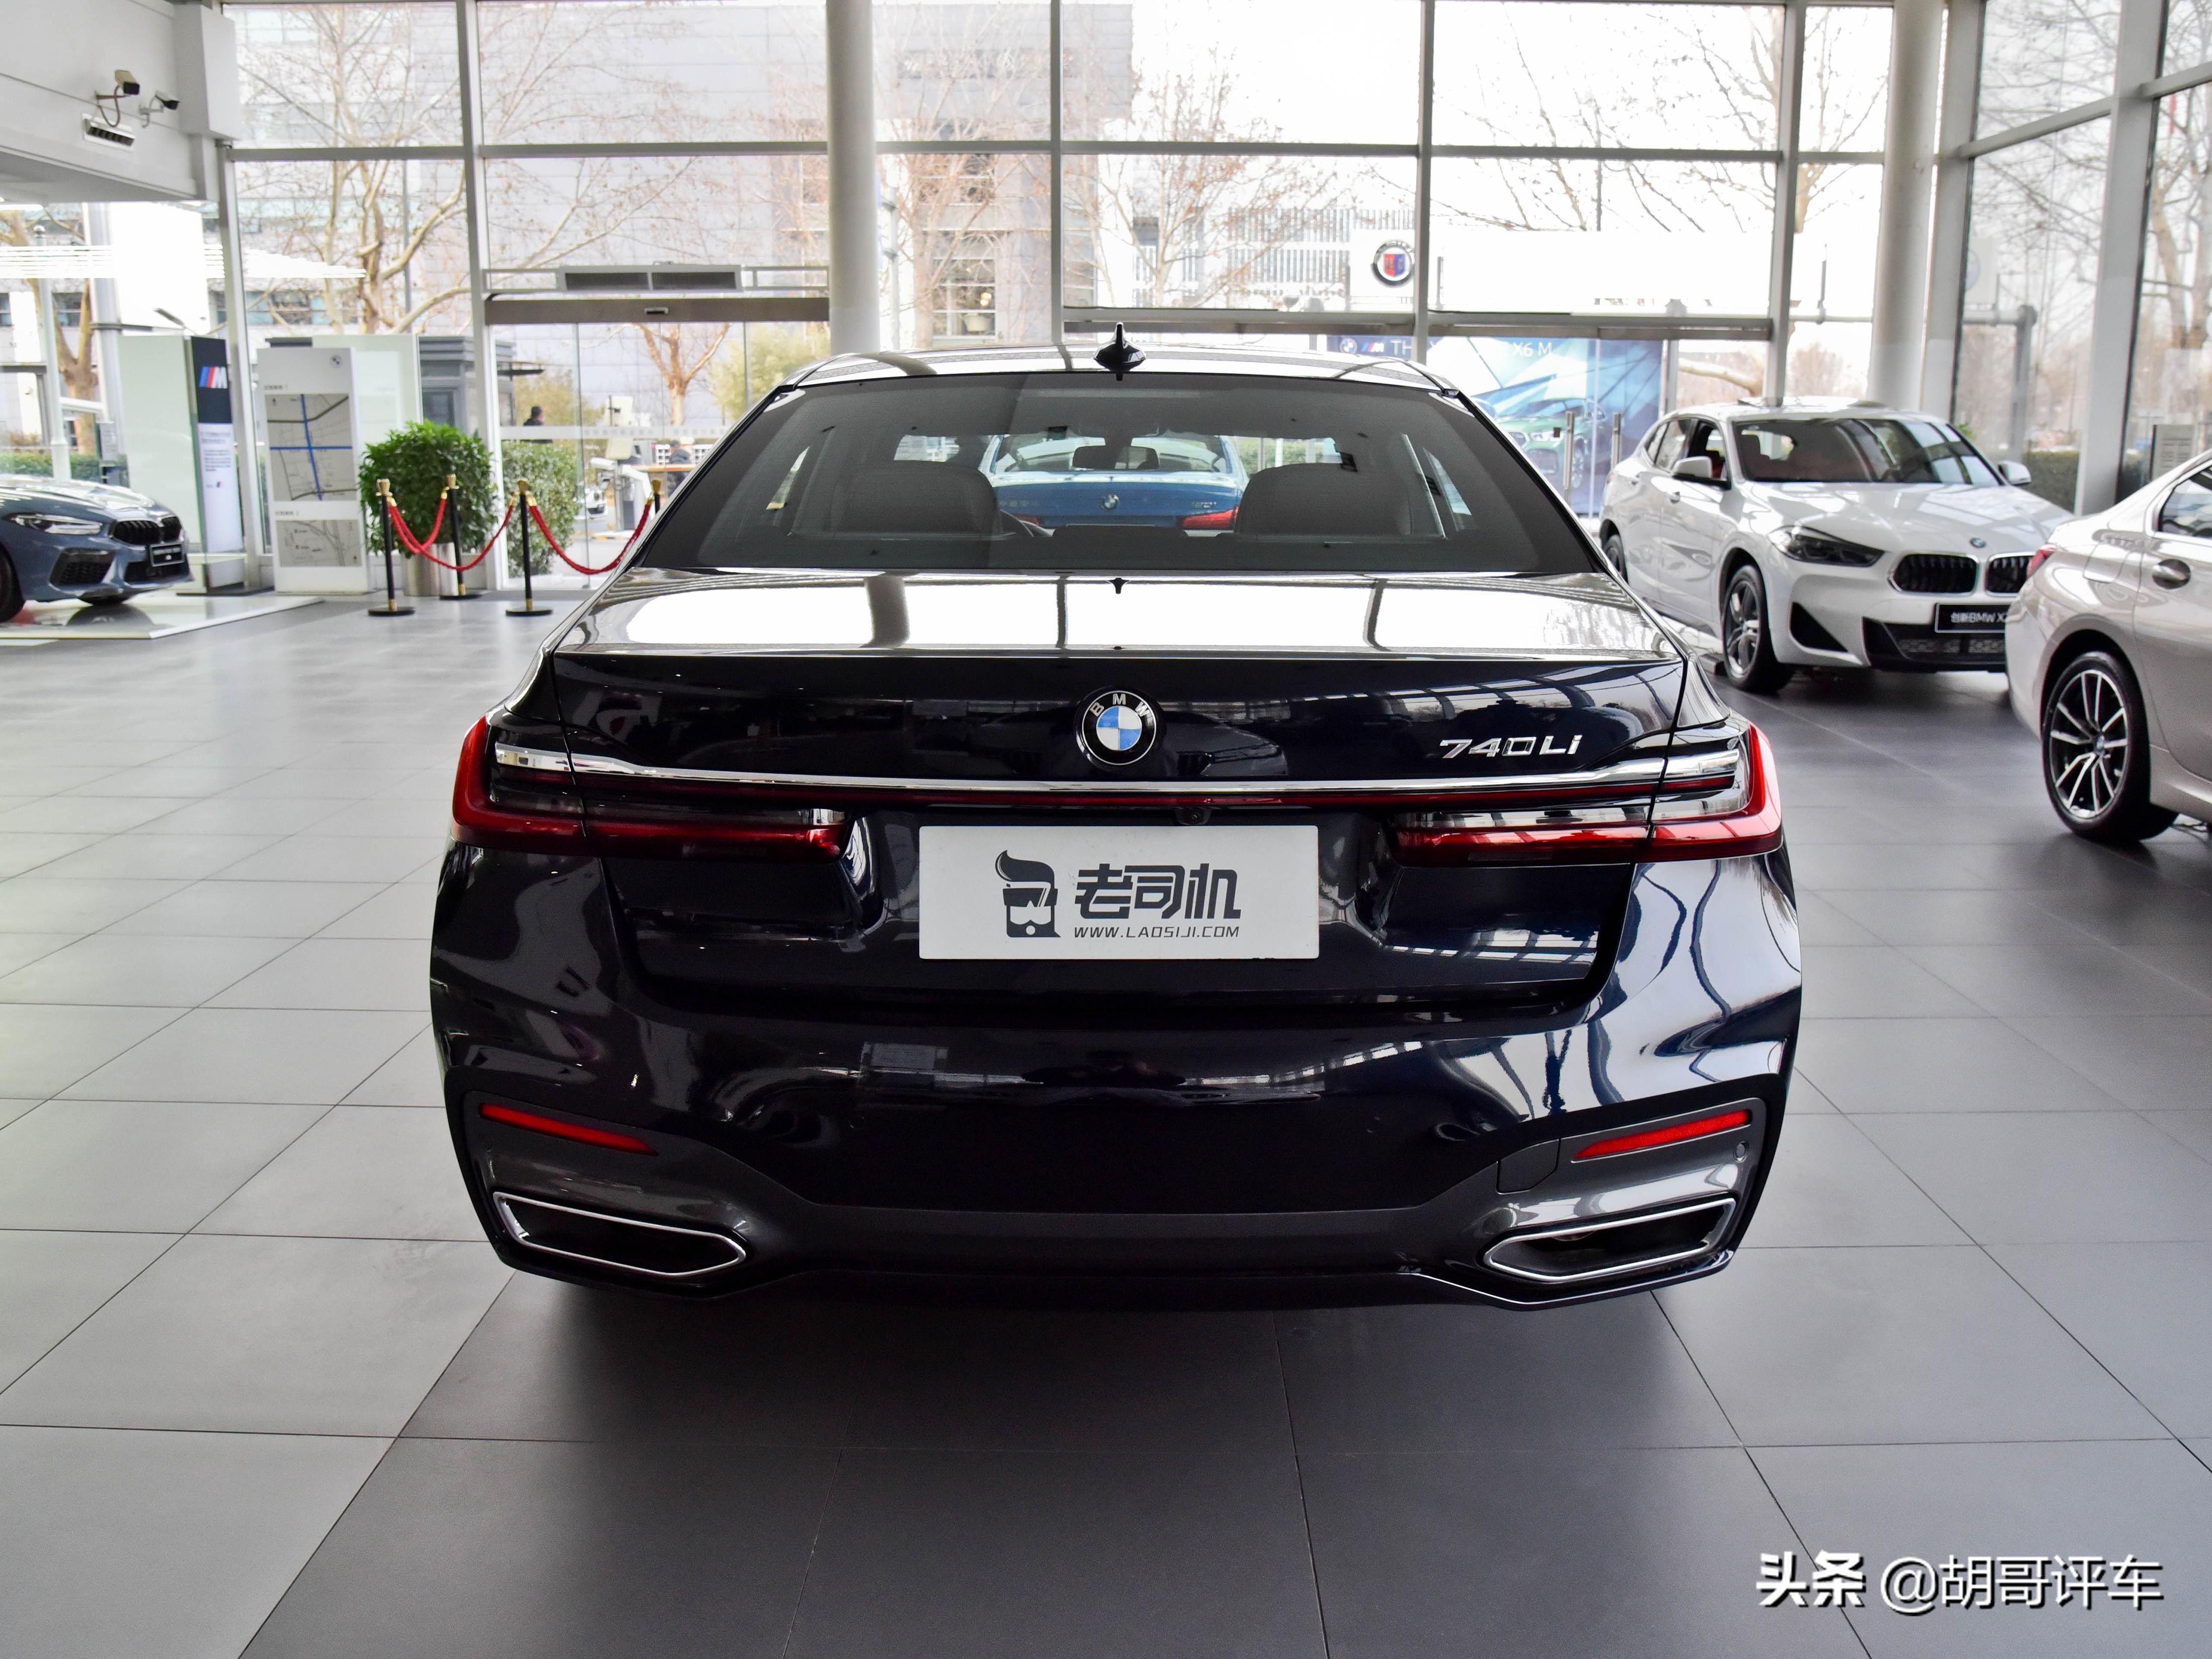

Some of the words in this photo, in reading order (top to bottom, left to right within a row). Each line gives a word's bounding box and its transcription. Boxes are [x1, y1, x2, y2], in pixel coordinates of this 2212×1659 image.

[1089, 693, 1150, 717] BMW
[1074, 863, 1242, 919] 老司机
[1074, 926, 1240, 938] WWW.LAOSIJI.COM
